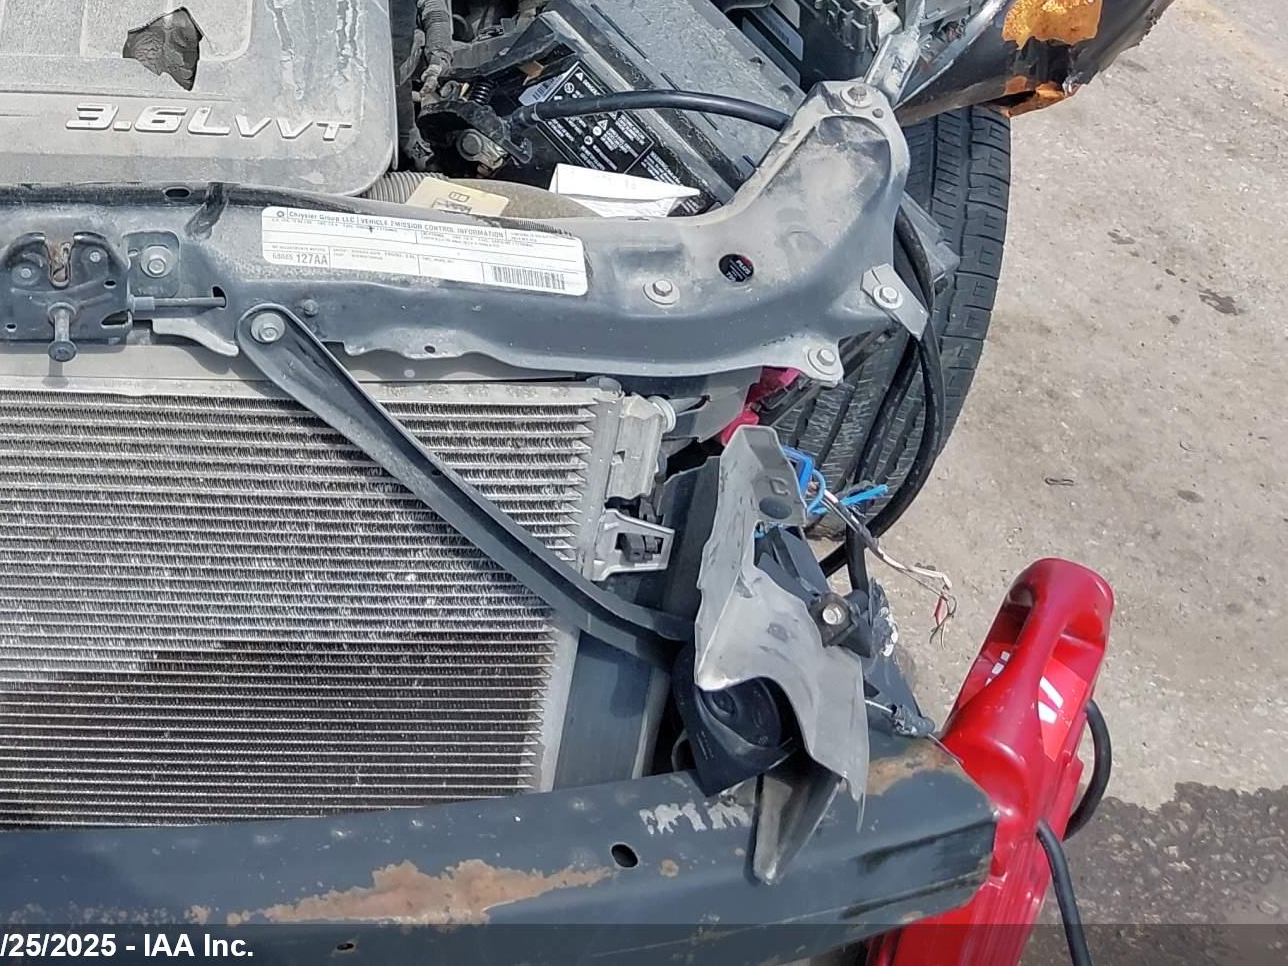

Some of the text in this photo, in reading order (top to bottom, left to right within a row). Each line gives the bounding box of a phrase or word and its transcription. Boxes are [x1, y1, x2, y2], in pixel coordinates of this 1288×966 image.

[235, 113, 353, 142] VVT
[288, 210, 318, 221] Chrysler
[319, 214, 340, 223] Group
[361, 218, 388, 226] VEHICLE
[391, 221, 423, 229] EMISSION
[424, 224, 454, 233] CONTROL
[457, 227, 504, 238] INFORMATION
[296, 253, 329, 265] 127AA
